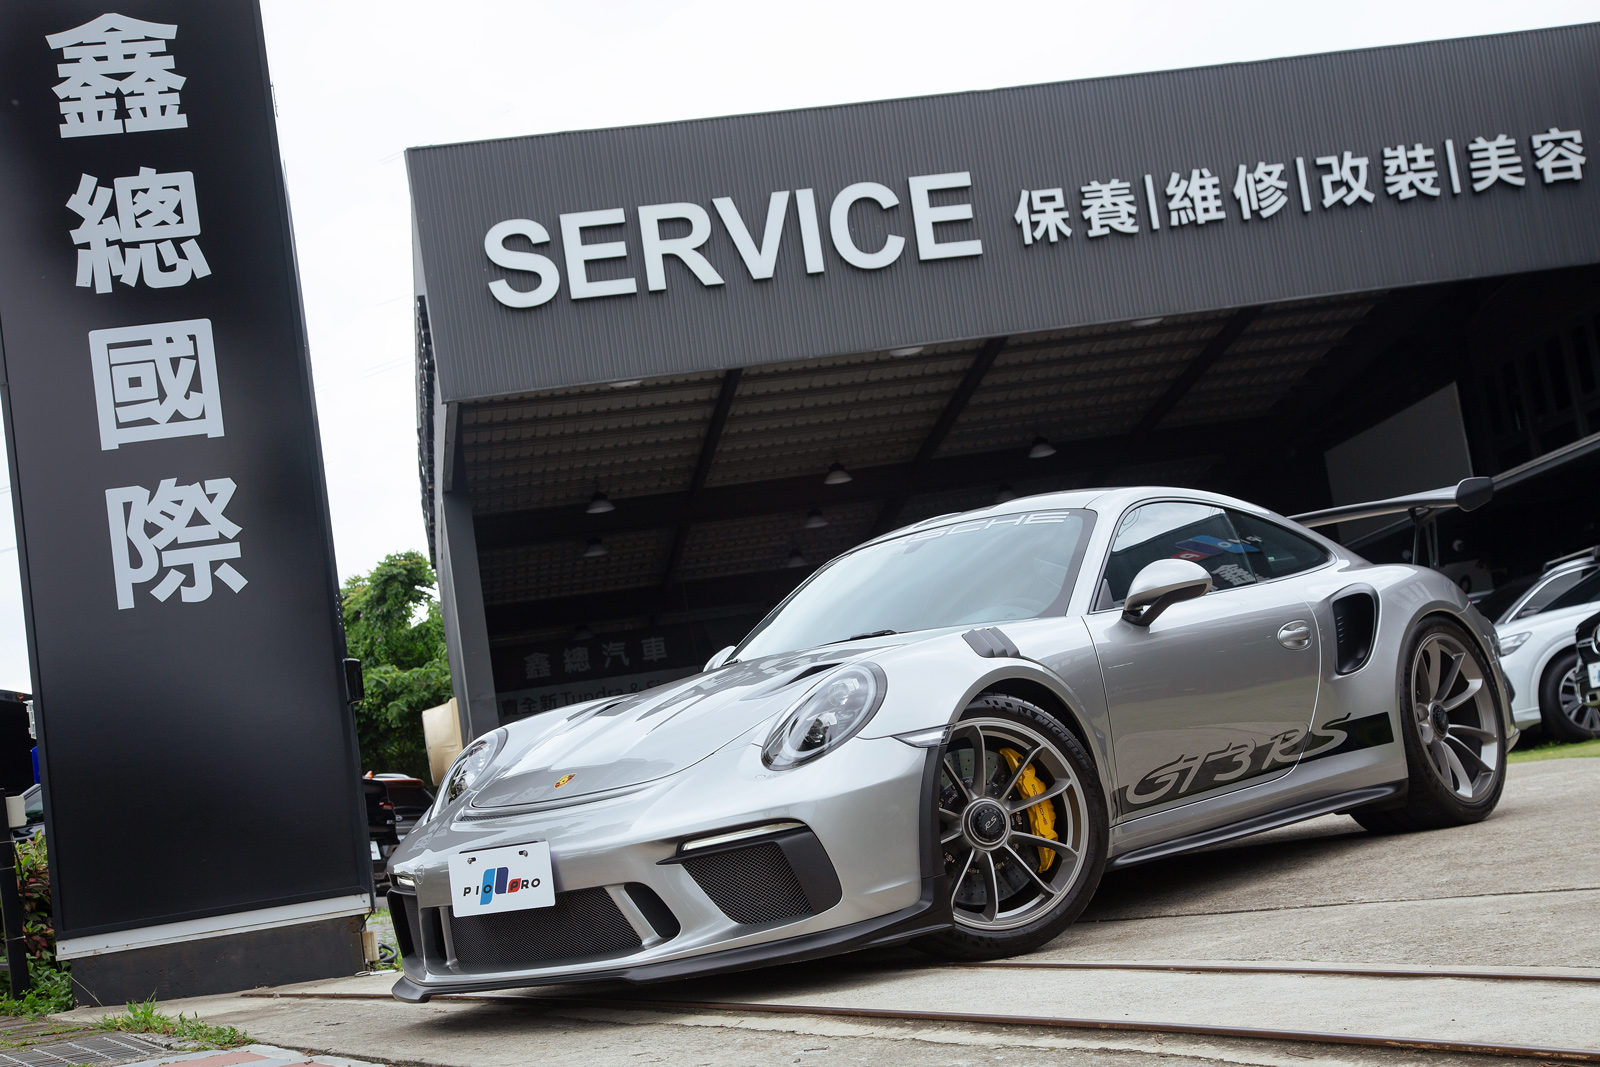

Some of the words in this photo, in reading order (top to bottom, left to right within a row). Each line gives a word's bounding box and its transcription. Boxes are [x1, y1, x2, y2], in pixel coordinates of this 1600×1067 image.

[484, 171, 983, 309] SERVICE
[45, 12, 248, 610] 鑫總國際
[523, 636, 667, 680] 鑫總汽車
[560, 686, 624, 706] Tundra
[1034, 715, 1090, 770] MICHELIN
[1126, 737, 1257, 805] GT3
[1261, 712, 1351, 771] RS
[1031, 783, 1048, 825] POSCHE
